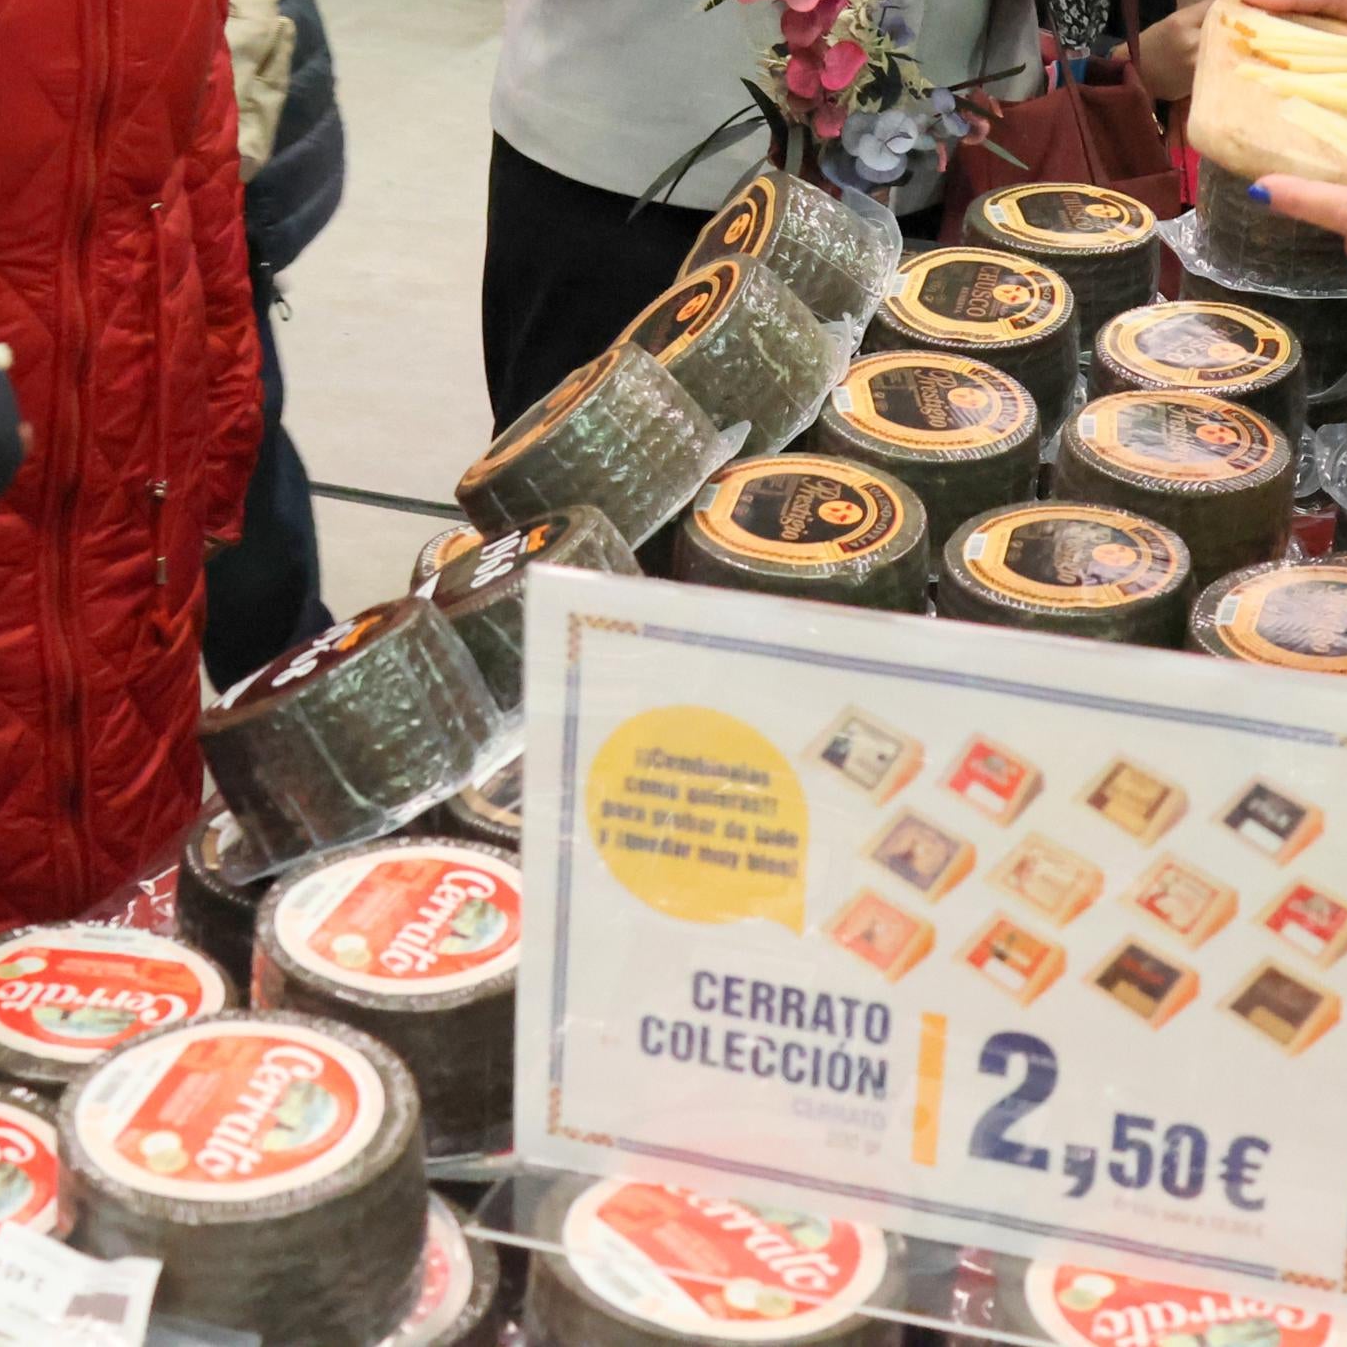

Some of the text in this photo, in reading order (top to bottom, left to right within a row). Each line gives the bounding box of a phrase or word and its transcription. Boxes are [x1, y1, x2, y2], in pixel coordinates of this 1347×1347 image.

[966, 264, 1001, 318] CHUSCO
[914, 367, 960, 429] Prestigio
[779, 475, 842, 541] Prestigio
[380, 870, 497, 975] Cerrato
[692, 970, 891, 1045] CERRATO
[640, 1015, 889, 1101] COLECCIÓN
[195, 1045, 325, 1177] Cerrato
